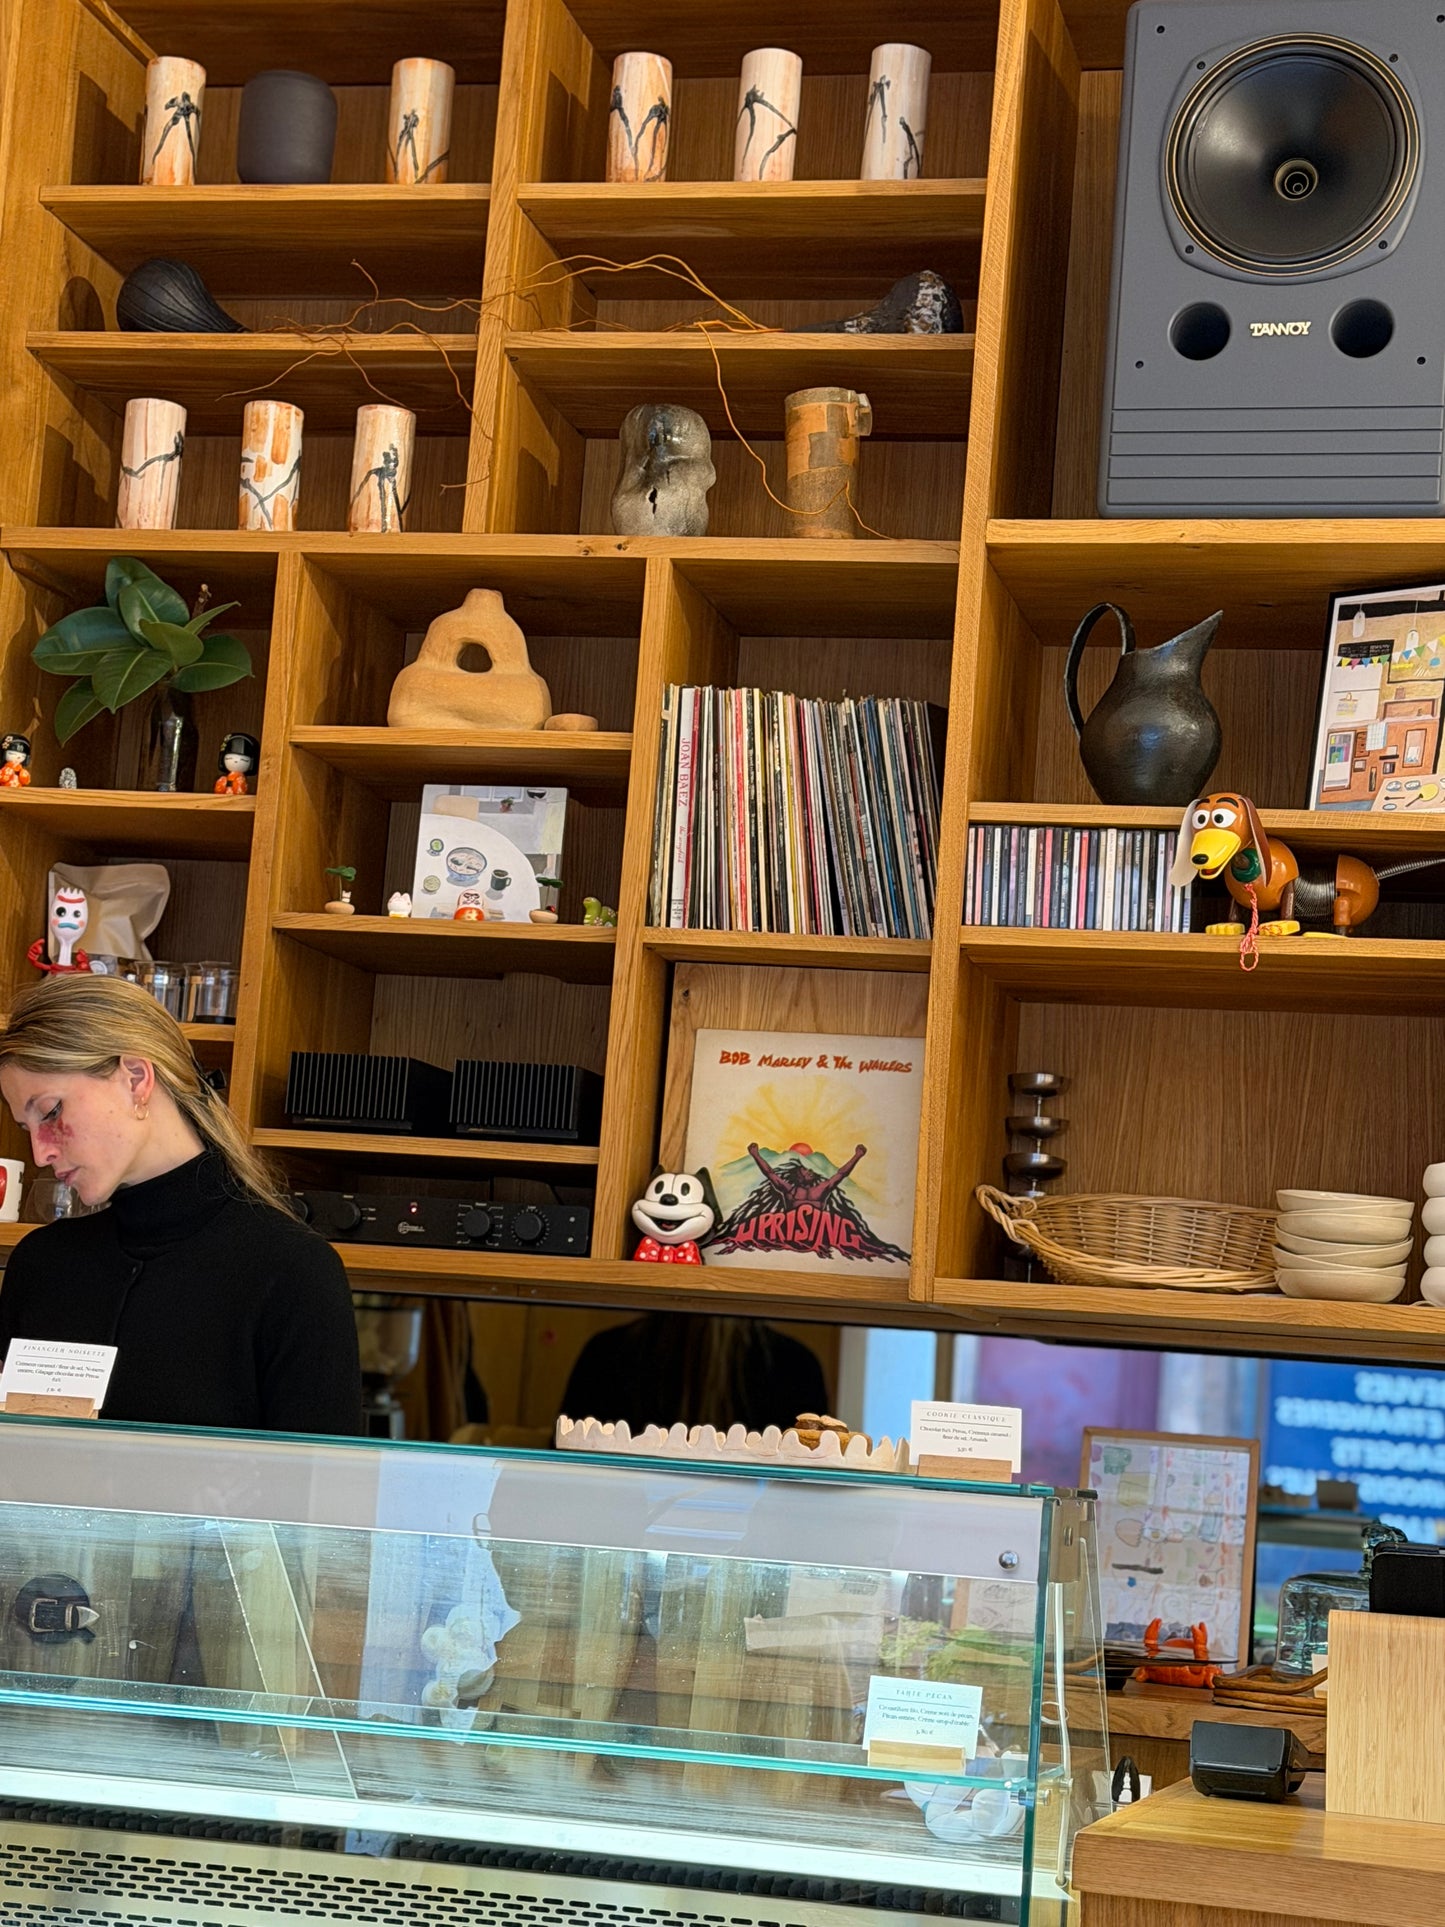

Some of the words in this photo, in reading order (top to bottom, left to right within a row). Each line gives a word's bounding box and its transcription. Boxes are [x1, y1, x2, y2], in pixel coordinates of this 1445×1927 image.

[1250, 321, 1312, 336] TANNOY
[680, 737, 691, 769] JOAN
[678, 773, 689, 807] BAEZ
[719, 1050, 751, 1065] BOB
[816, 1054, 829, 1069] &
[734, 1203, 862, 1248] UPRISING
[927, 1410, 956, 1418] COOKIE
